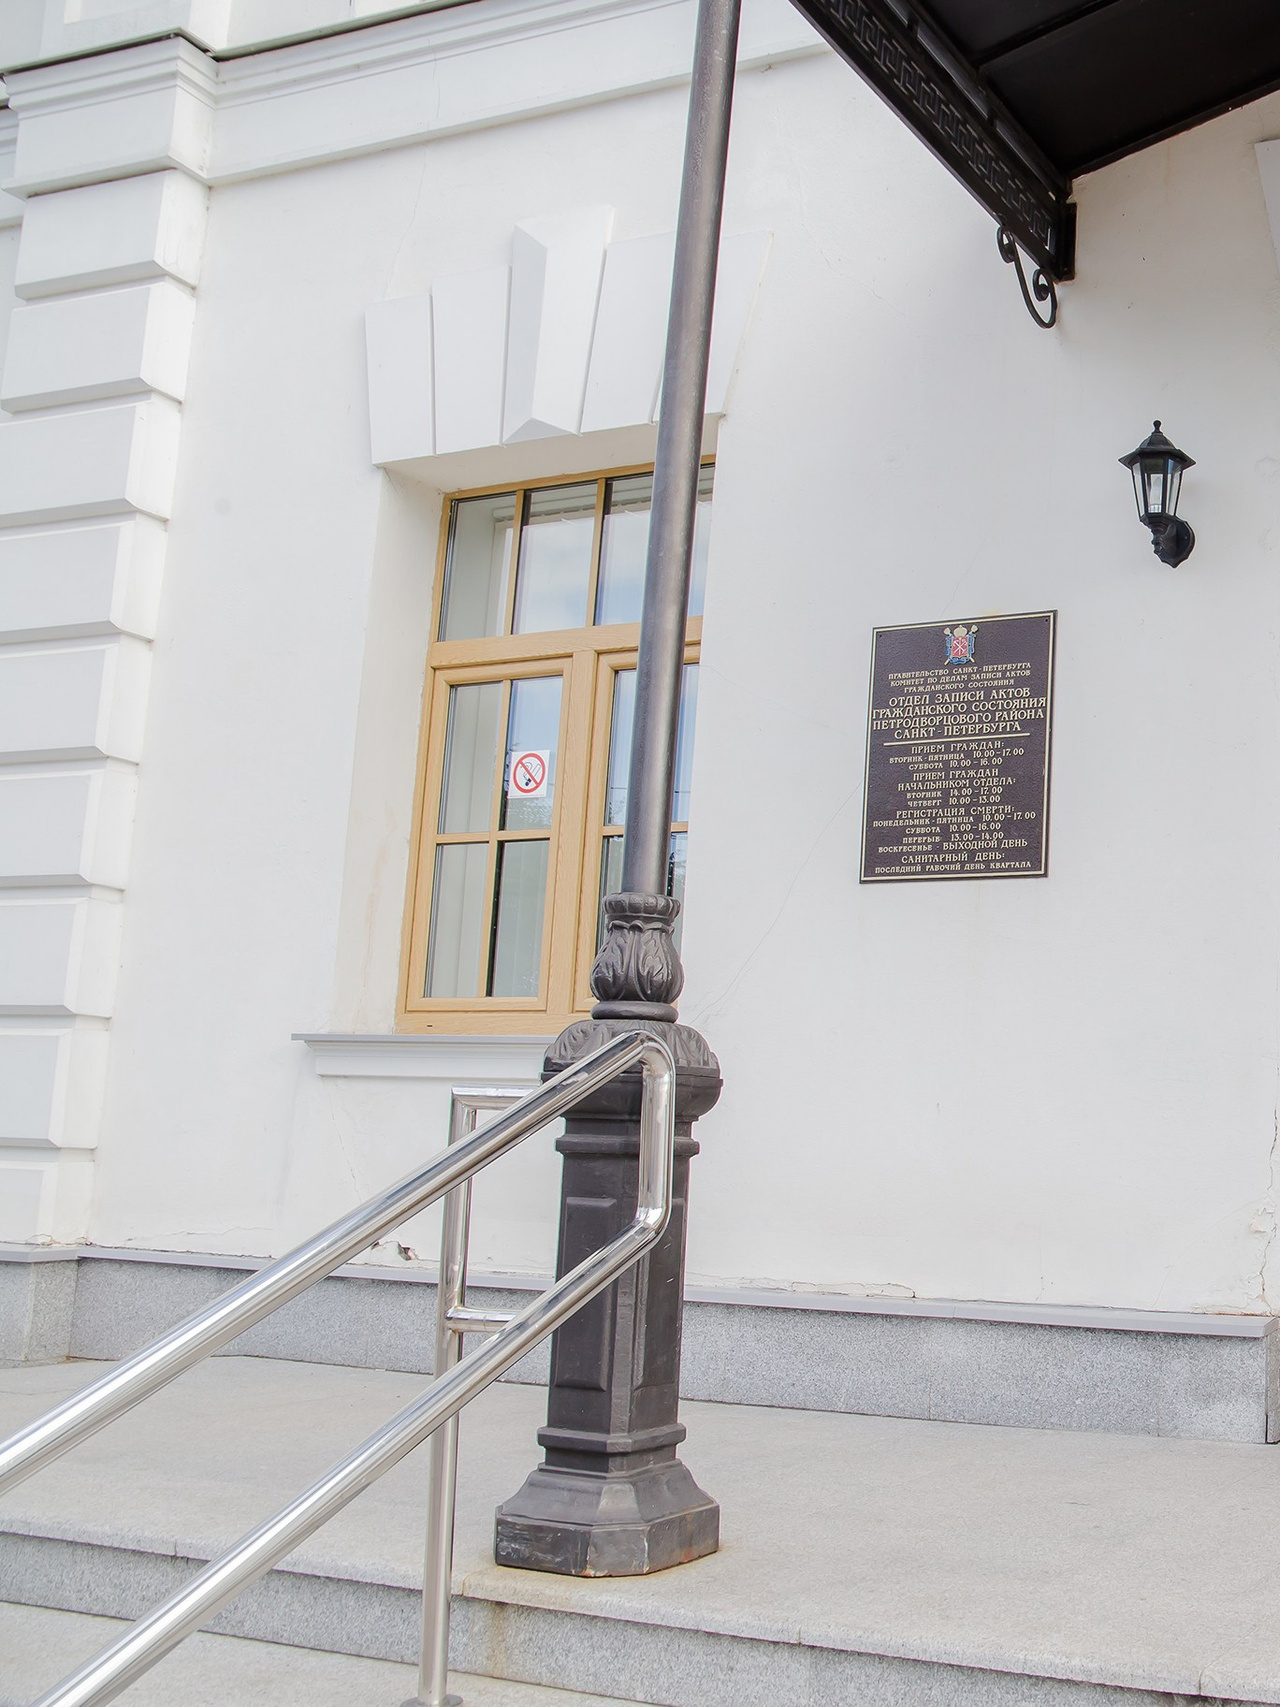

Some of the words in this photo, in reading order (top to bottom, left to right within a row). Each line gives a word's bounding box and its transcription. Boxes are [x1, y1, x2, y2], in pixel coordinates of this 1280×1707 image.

[889, 669, 949, 680] ПРАВИТЕЛЬСТВО
[890, 678, 925, 687] КОМИТЕТ
[940, 675, 968, 683] ДЕЛАМ
[971, 672, 1002, 680] ЗАПИСИ
[1005, 670, 1031, 678] АКТОВ
[904, 683, 965, 693] ГРАЖДАНСКОГО
[968, 679, 1014, 688] СОСТОЯНИЯ
[889, 695, 929, 707] ОТДЕЛ
[935, 690, 984, 703] ЗАПИСИ
[990, 687, 1031, 699] АКТОВ
[872, 703, 967, 719] ГРАЖДАНСКОГО
[972, 697, 1046, 712] СОСТОЯНИЯ
[873, 712, 992, 730] ПЕТРОДВОРЦОВОГО
[995, 708, 1044, 721] РАЙОНА
[911, 744, 945, 754] ПРИЕМ
[951, 741, 1004, 751] ГРАЖДАН:
[908, 762, 943, 770] СУББОТА
[913, 771, 945, 781] ПРИЕМ
[950, 769, 999, 779] ГРАЖДАН
[898, 779, 969, 791] НАЧАЛЬНИКОМ
[973, 777, 1016, 787] ОТДЕЛА:
[906, 791, 942, 799] ВТОРНИК
[907, 799, 942, 807] ЧЕТВЕРГ
[896, 807, 965, 819] РЕГИСТРАЦИЯ
[971, 805, 1015, 815] СМЕРТИ:
[906, 826, 941, 834] СУББОТА
[878, 845, 933, 853] ВОСКРЕСЕНЬЕ
[943, 839, 997, 851] ВЫХОДНОЙ
[1001, 839, 1028, 848] ДЕНЬ
[902, 836, 941, 844] ПЕРЕРЫВ
[901, 852, 968, 863] САНИТАРНЫЙ
[974, 852, 1005, 861] ДЕНЬ:
[875, 864, 921, 873] ПОСЛЕДНИЙ
[925, 863, 961, 871] РАБОЧИЙ
[990, 861, 1031, 869] КВАРТАЛА
